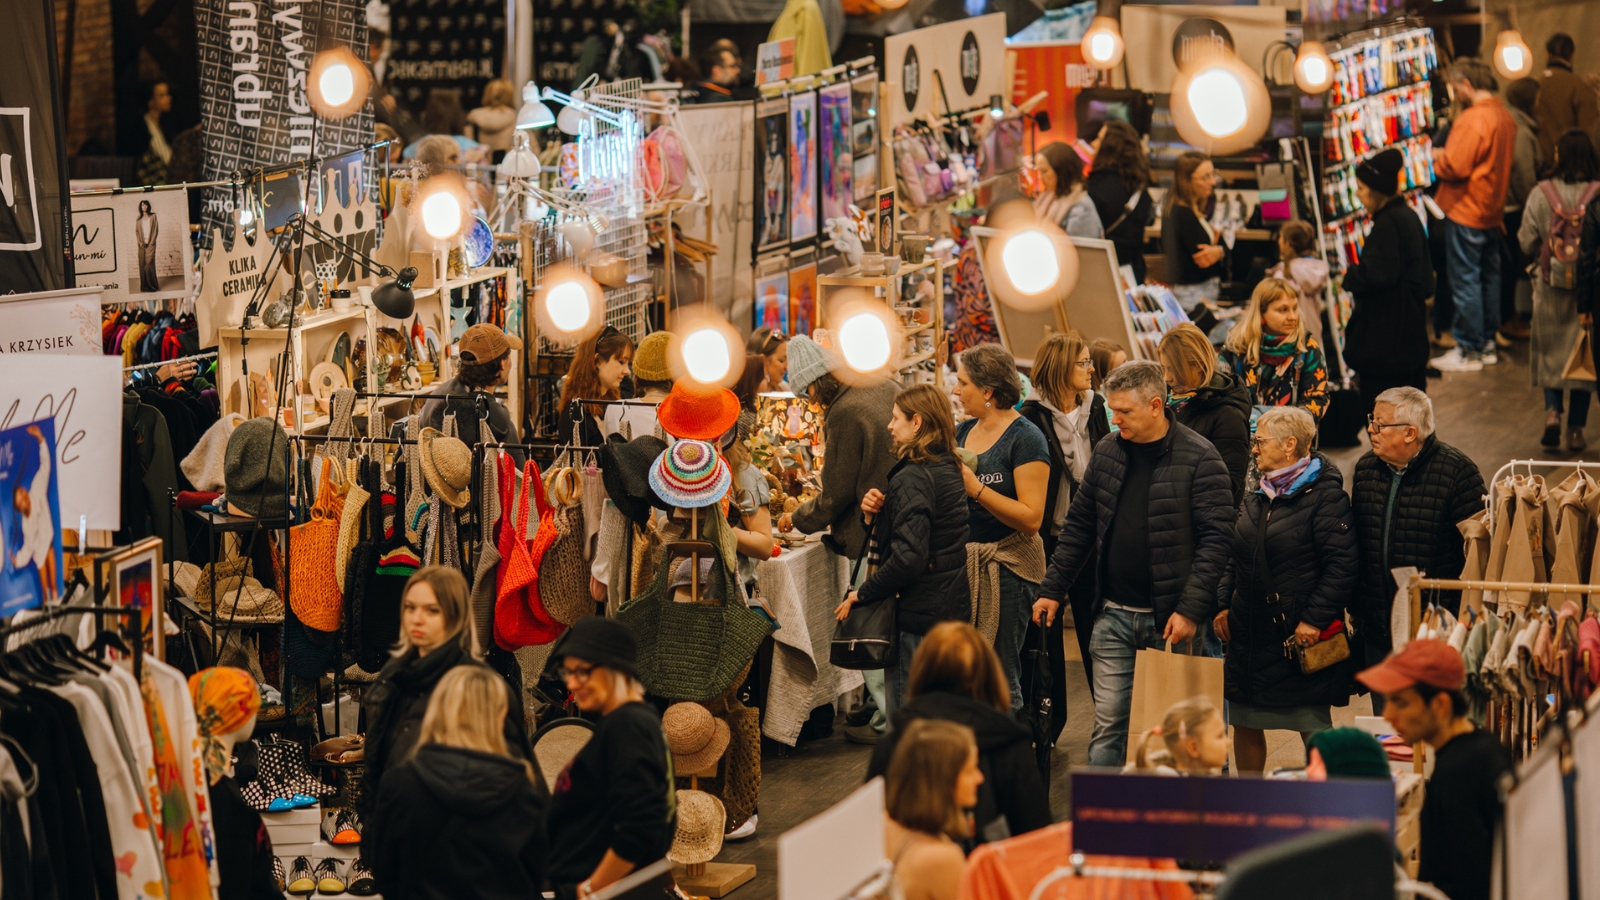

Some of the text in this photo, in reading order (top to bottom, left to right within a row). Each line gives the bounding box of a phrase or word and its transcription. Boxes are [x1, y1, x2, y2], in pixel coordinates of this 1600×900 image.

[74, 249, 107, 260] un-mi
[229, 255, 257, 276] KLIKA
[9, 335, 74, 354] KRZYSIEK
[976, 472, 1004, 485] ton
